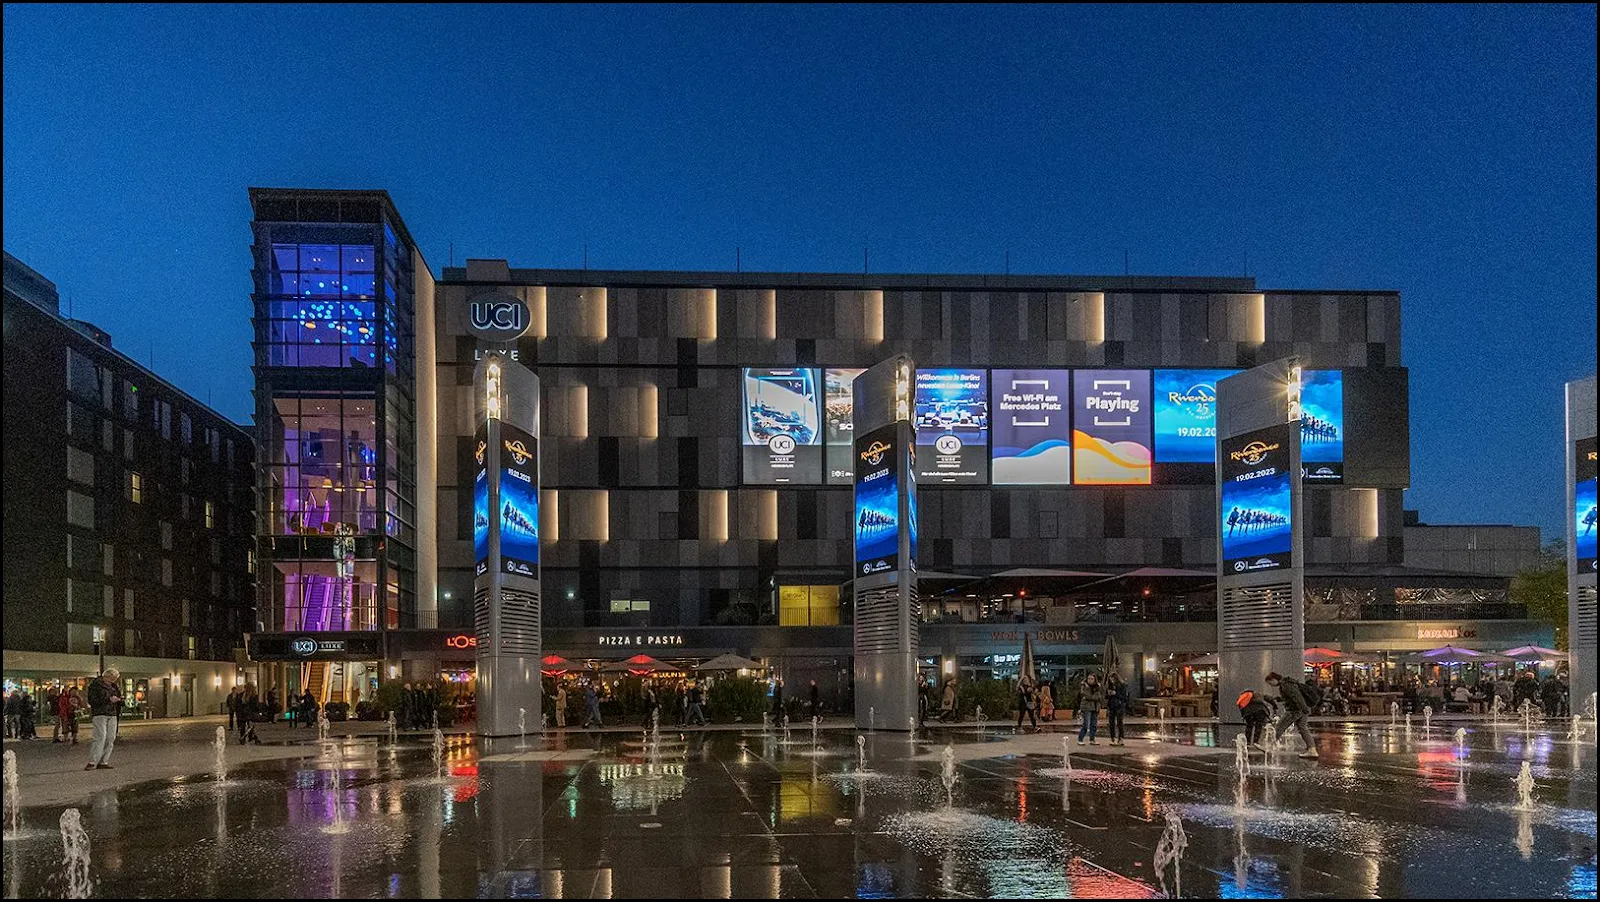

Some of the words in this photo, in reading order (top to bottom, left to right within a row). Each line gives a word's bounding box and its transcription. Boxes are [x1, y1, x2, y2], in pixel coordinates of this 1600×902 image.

[470, 302, 521, 331] UCI
[1003, 394, 1022, 402] Free
[1045, 394, 1058, 402] am
[1000, 402, 1040, 411] Mercedes
[1041, 402, 1062, 411] Platz
[1086, 396, 1140, 413] Playing
[1196, 402, 1209, 416] 25
[774, 441, 791, 450] UCI
[940, 440, 957, 450] UCI
[1235, 467, 1276, 482] 19.02.2023
[599, 636, 631, 646] PIZZA
[636, 636, 642, 645] E
[647, 635, 683, 645] PASTA
[1036, 630, 1079, 641] BOWLS
[294, 640, 314, 652] UCI
